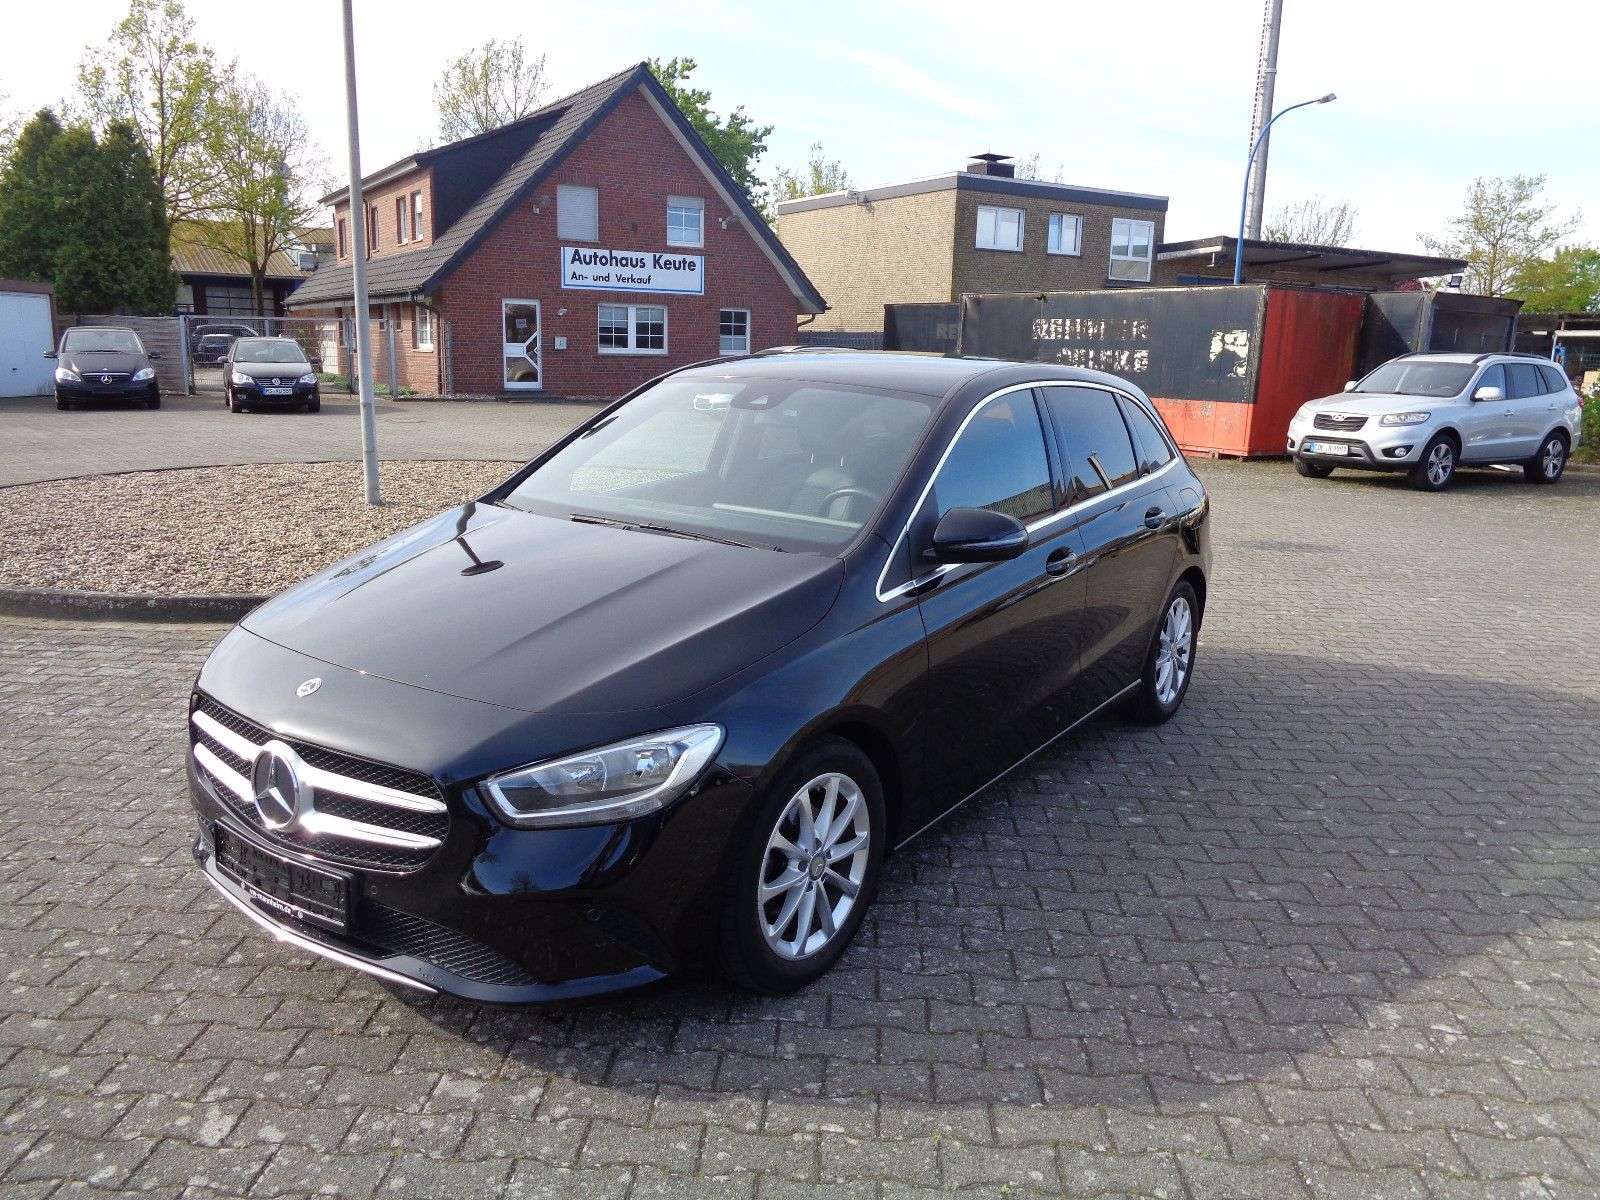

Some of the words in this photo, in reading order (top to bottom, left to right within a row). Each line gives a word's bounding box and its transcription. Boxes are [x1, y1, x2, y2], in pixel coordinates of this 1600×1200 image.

[570, 249, 646, 269] Autohaus
[653, 254, 697, 272] Keute
[570, 271, 589, 281] An-
[592, 273, 610, 283] und
[616, 274, 652, 285] Verkauf
